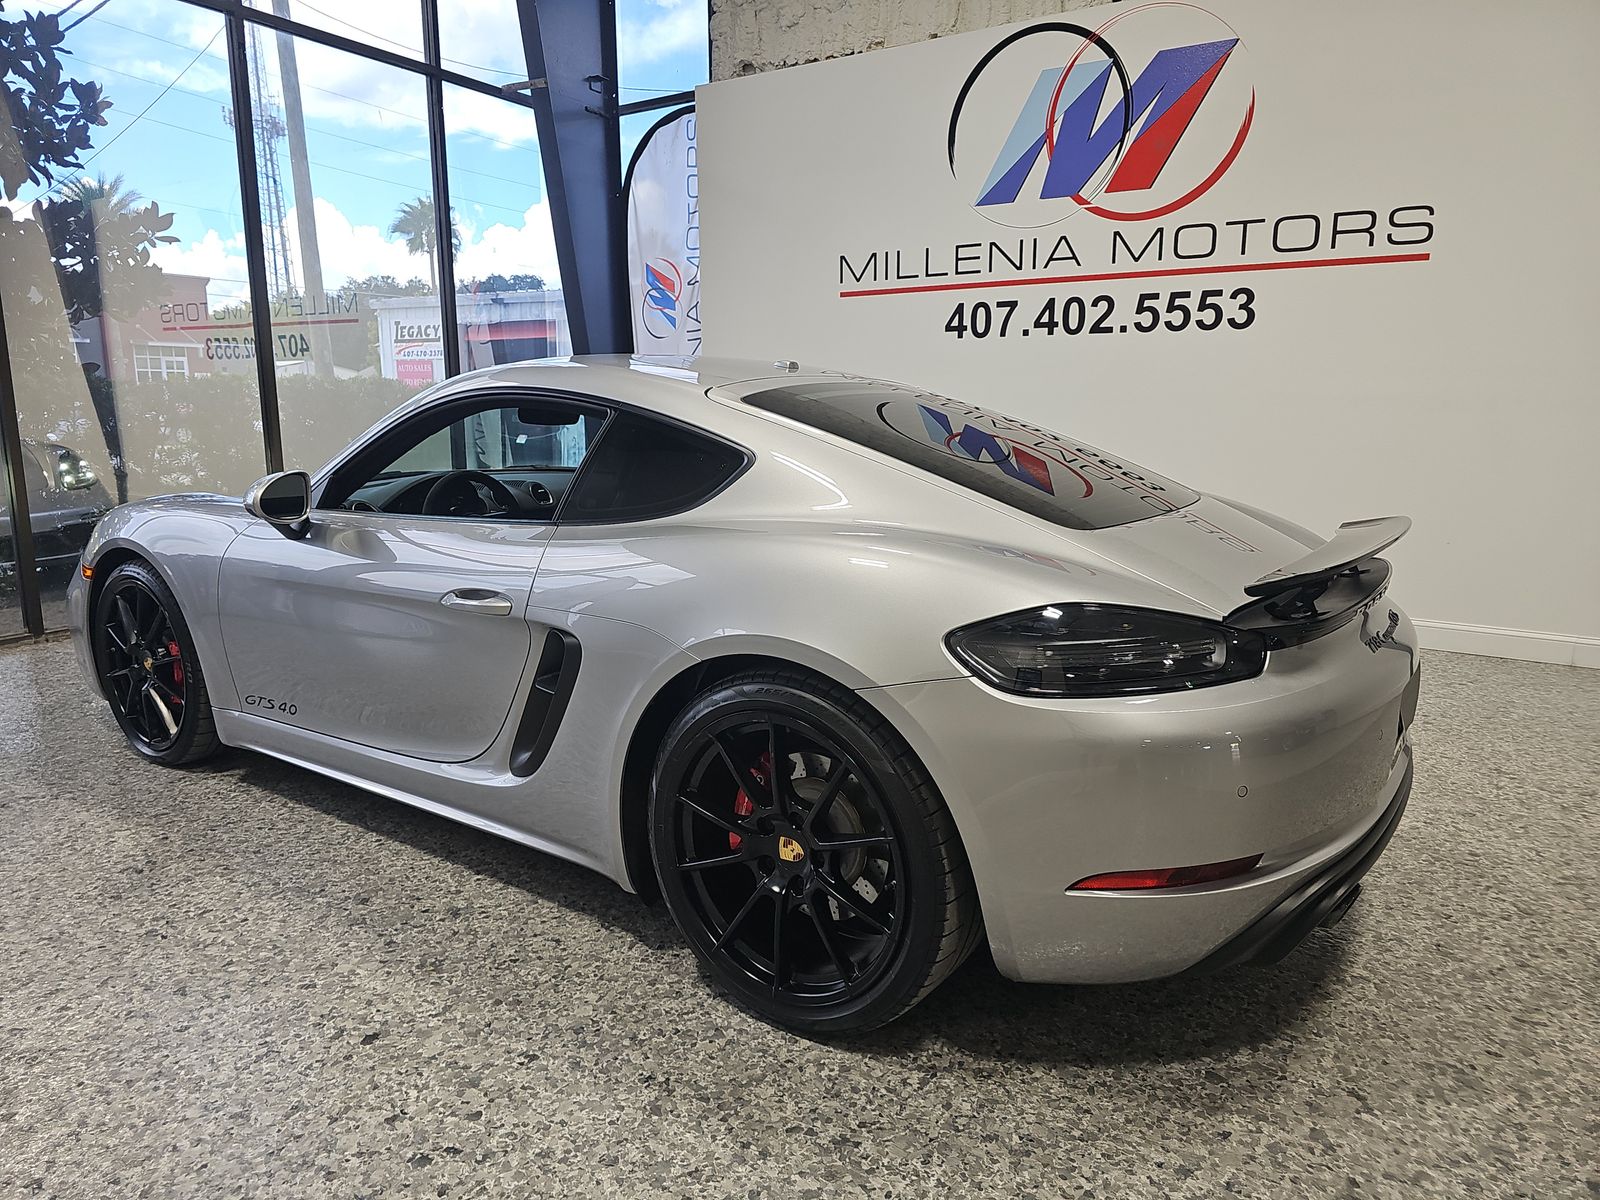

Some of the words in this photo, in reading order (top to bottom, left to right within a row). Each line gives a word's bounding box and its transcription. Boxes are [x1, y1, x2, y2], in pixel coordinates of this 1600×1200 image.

[840, 236, 1081, 284] MILLENIA
[1112, 206, 1435, 264] MOTORS
[945, 288, 1256, 338] 407.402.5553
[394, 321, 441, 343] LEGACY
[245, 695, 275, 709] GTS
[278, 702, 297, 715] 4.0
